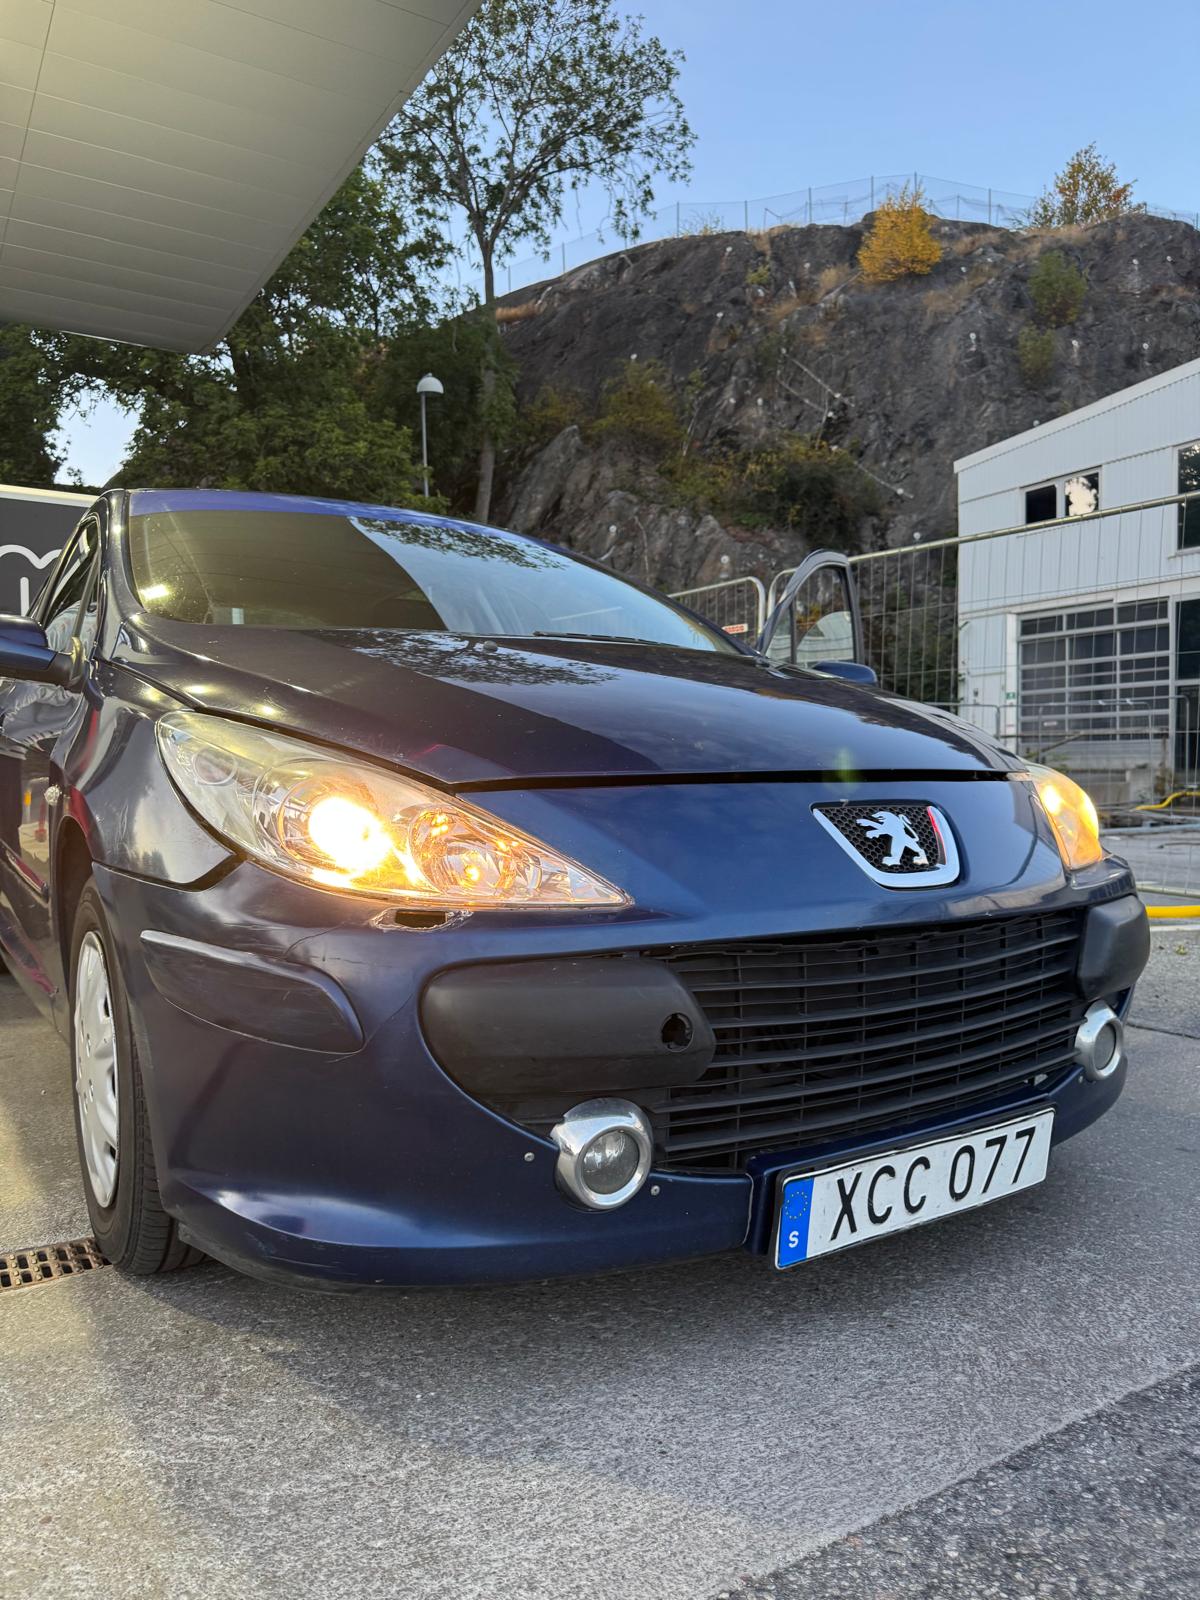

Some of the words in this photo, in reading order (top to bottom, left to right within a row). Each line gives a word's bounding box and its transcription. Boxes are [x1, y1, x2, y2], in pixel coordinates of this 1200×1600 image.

[830, 1156, 931, 1241] XCC
[949, 1126, 1037, 1201] 077
[787, 1230, 799, 1248] S
